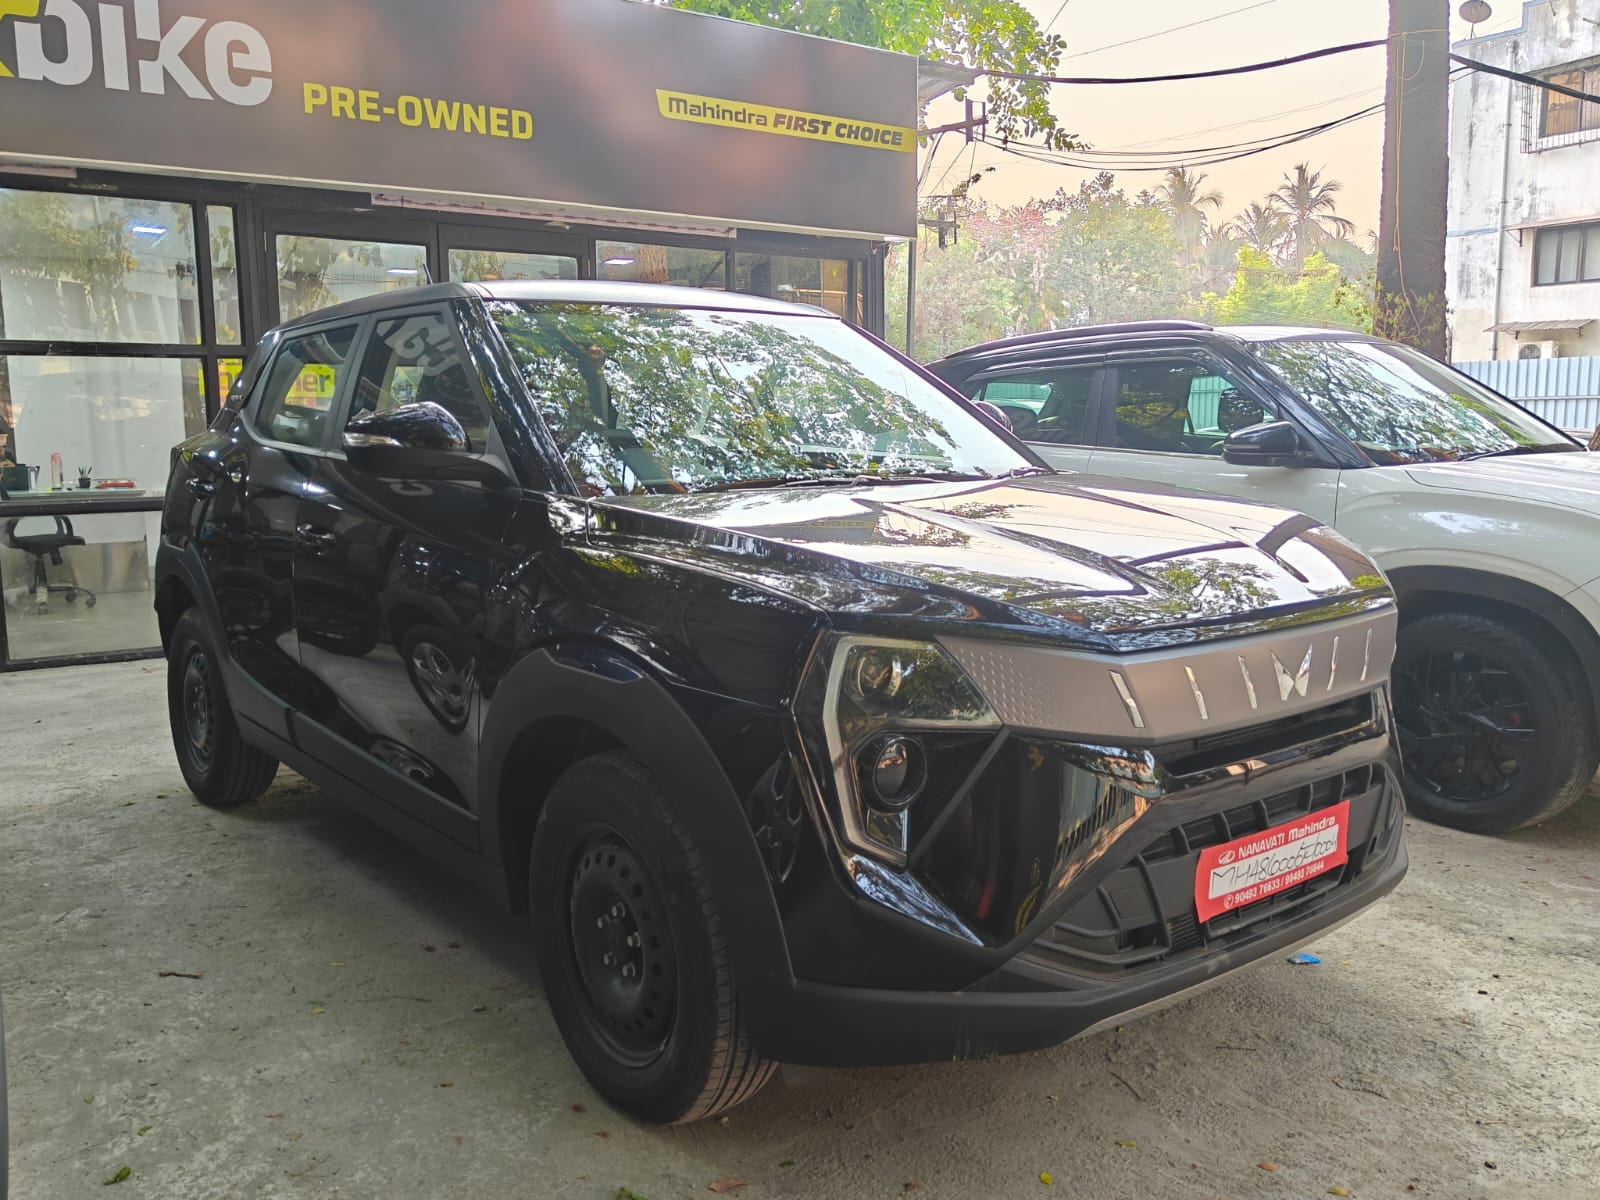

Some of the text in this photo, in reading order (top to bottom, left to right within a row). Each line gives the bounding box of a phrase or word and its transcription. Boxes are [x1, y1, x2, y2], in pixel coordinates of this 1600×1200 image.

[303, 82, 534, 140] PRE-OWNED
[668, 96, 903, 146] Mahindra FIRST CHOICE
[1238, 816, 1336, 859] NANAVATI Mahindra
[1234, 887, 1257, 903] 90493
[1259, 879, 1280, 894] 76633
[1284, 868, 1304, 885] 90493
[1305, 859, 1325, 876] 76644
